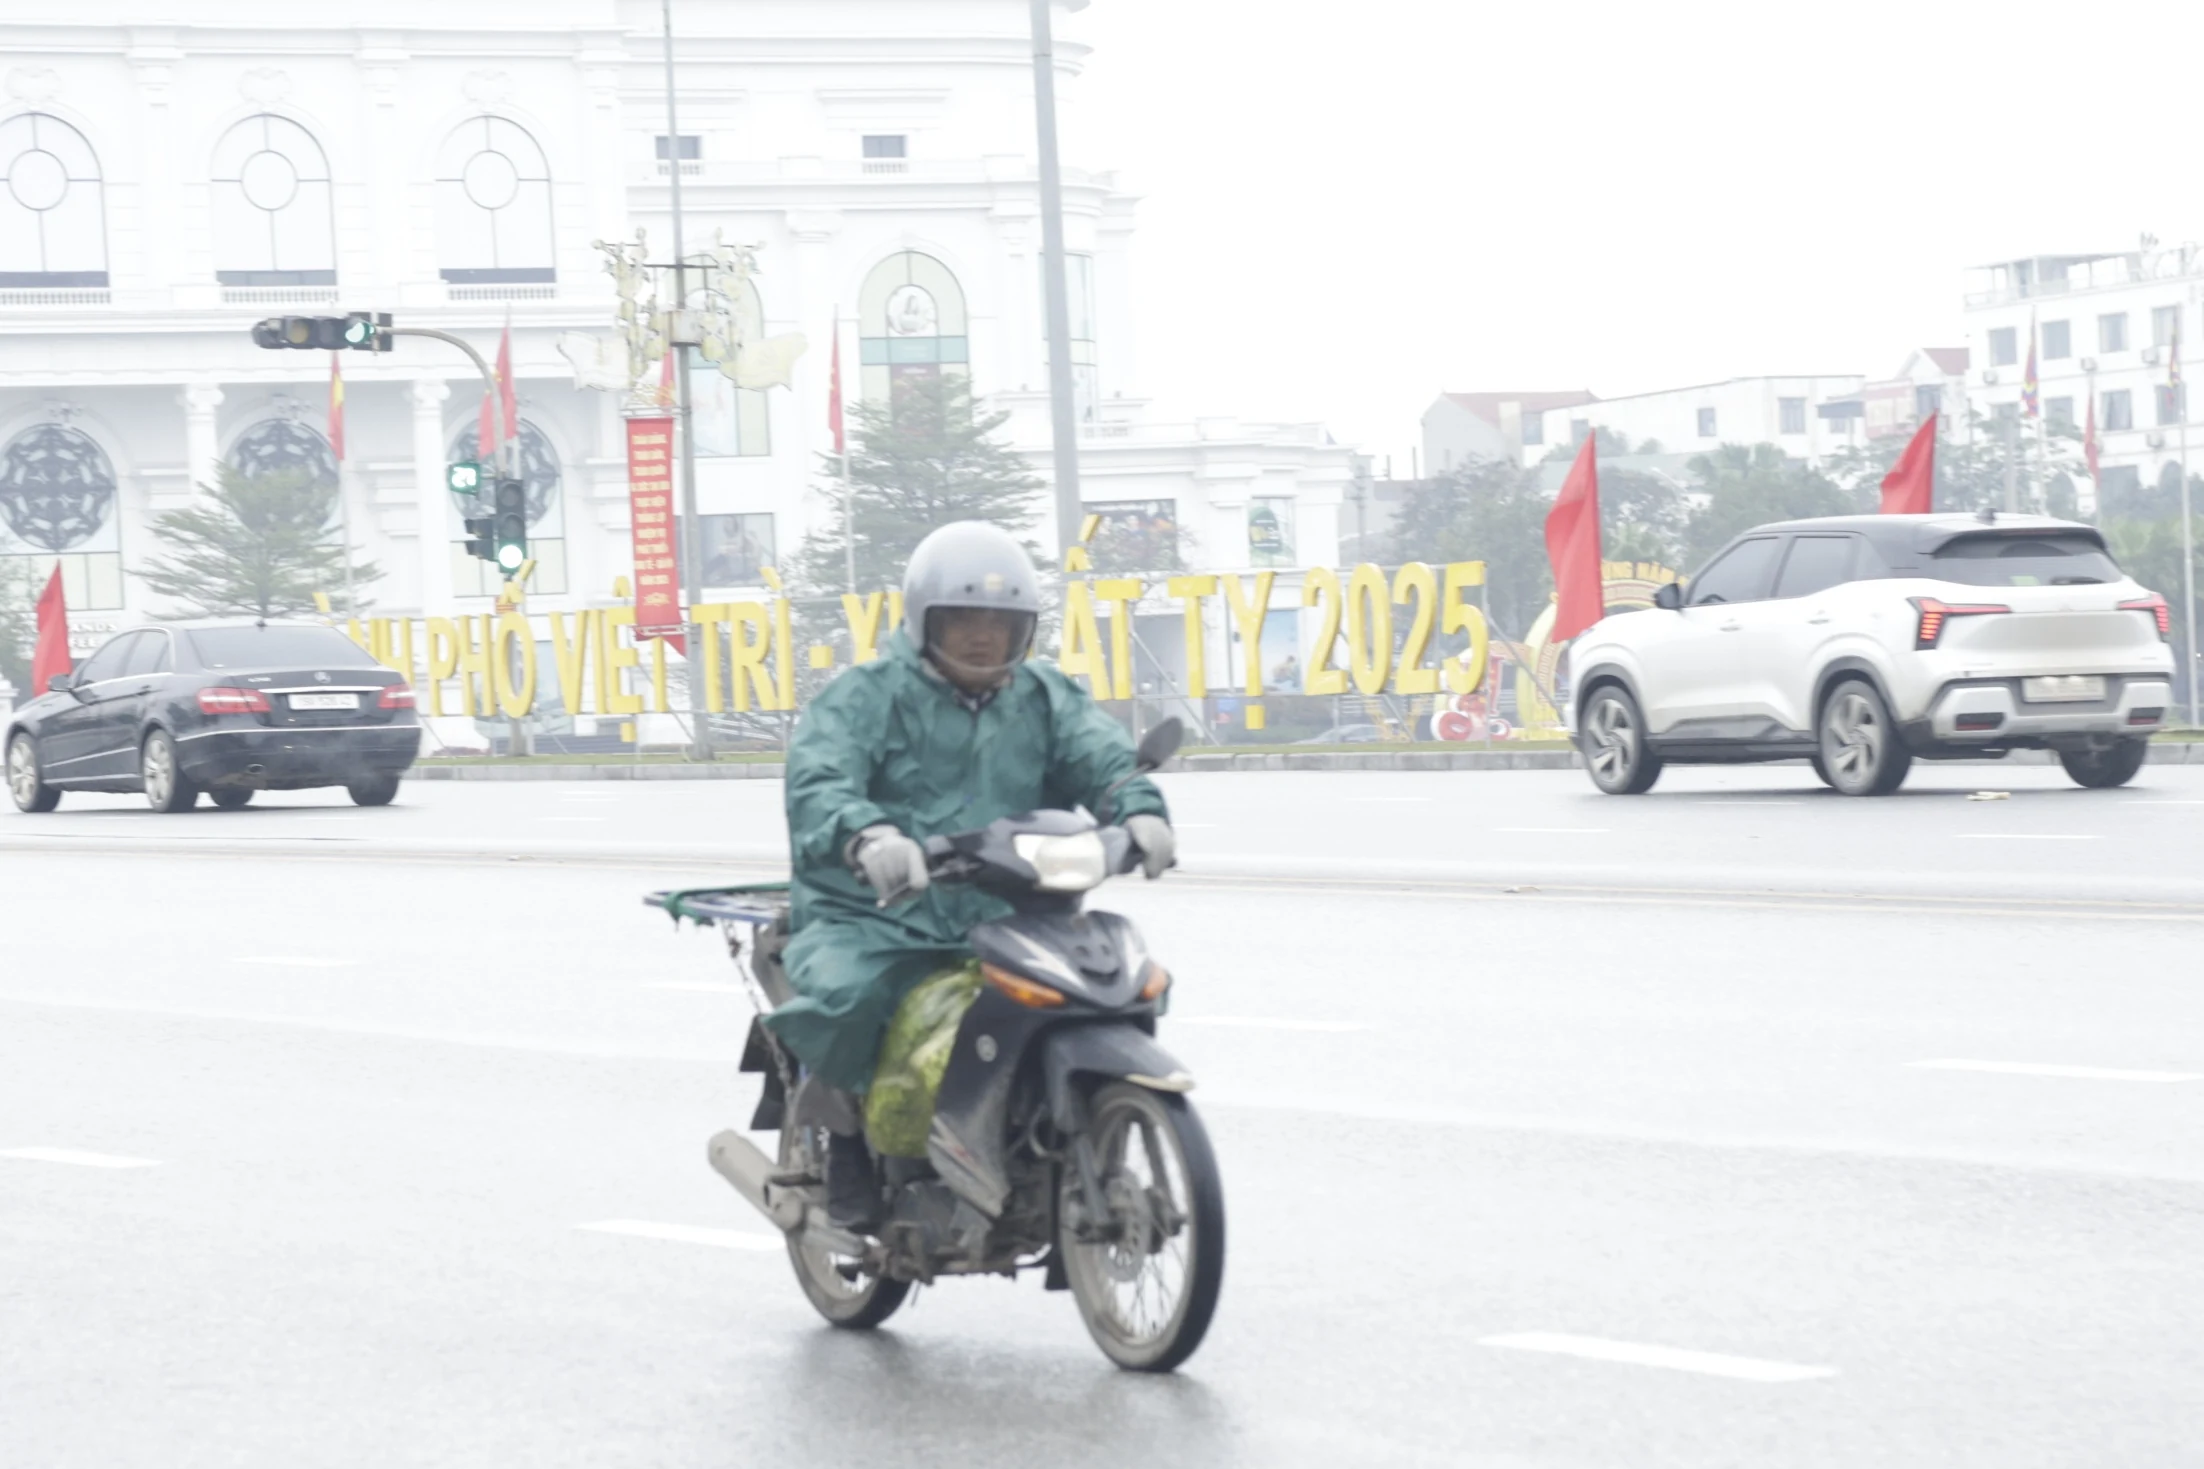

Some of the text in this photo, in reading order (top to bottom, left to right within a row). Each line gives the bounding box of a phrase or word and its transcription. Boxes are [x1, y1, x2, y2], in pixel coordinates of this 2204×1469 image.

[426, 559, 537, 716] PHỐ
[690, 565, 795, 713] TRÌ
[1059, 514, 1142, 700] ẤT
[1168, 571, 1275, 731] TỴ
[1303, 560, 1488, 696] 2025
